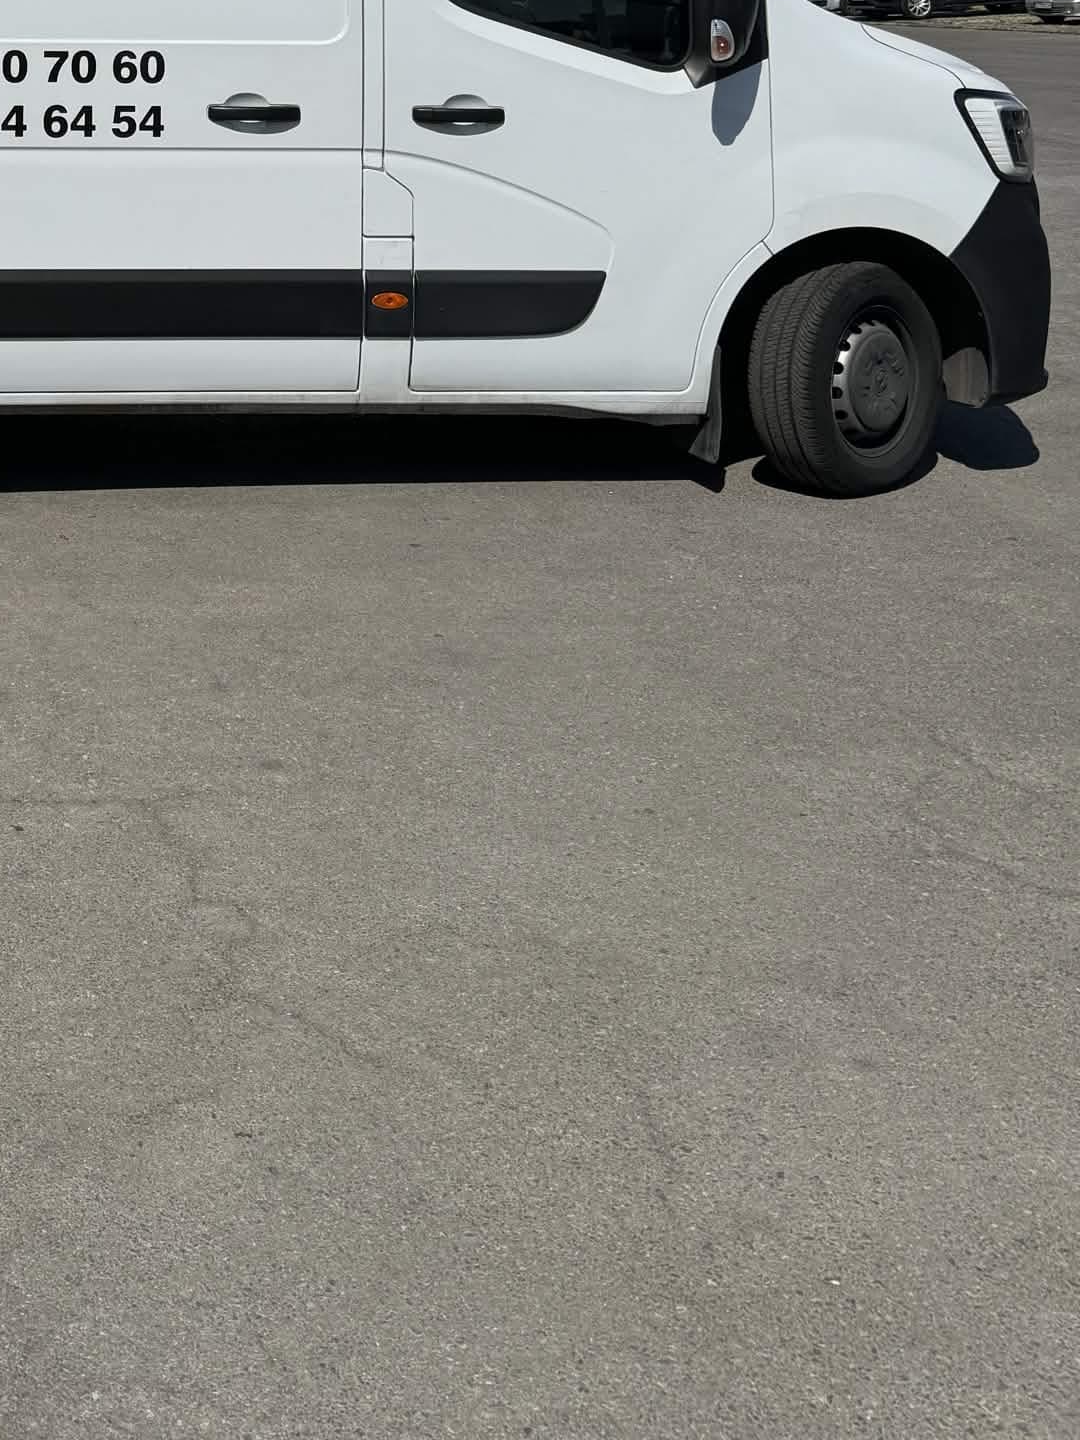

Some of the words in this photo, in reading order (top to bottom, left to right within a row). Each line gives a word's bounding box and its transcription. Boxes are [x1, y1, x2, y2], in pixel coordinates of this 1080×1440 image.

[43, 50, 97, 84] 70
[112, 50, 165, 84] 60
[43, 105, 97, 139] 64
[111, 105, 165, 139] 54
